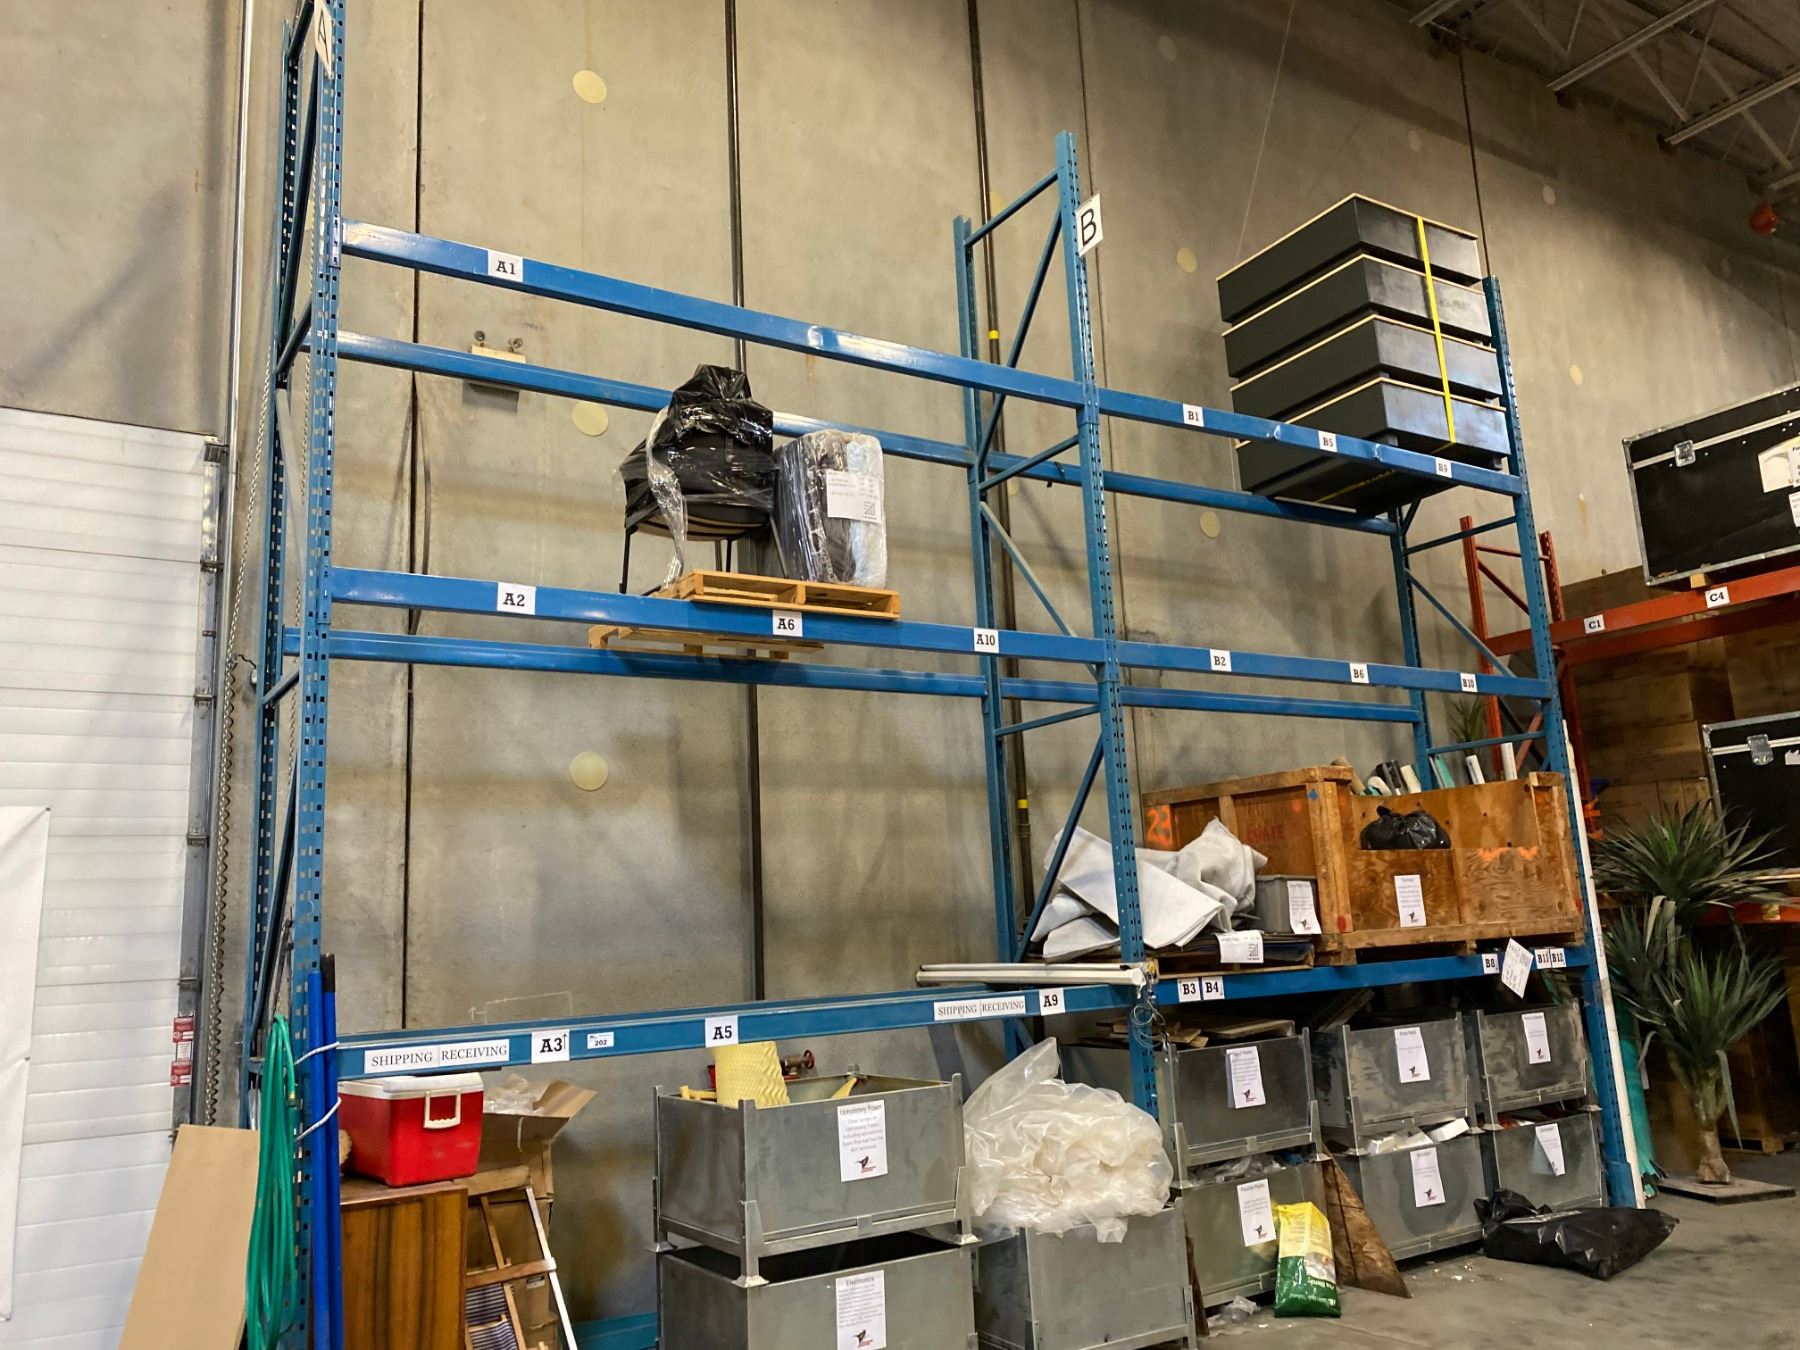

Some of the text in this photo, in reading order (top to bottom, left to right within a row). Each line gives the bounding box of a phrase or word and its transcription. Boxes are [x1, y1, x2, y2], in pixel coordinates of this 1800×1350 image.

[317, 9, 330, 64] A
[1081, 208, 1097, 247] B
[495, 260, 516, 275] A1
[1188, 410, 1200, 422] B1
[1323, 437, 1334, 447] B5
[1438, 462, 1448, 473] B9
[502, 592, 525, 607] A2
[1709, 591, 1724, 602] C4
[777, 618, 795, 630] A6
[1588, 621, 1602, 630] C1
[976, 634, 996, 646] A10
[1213, 656, 1227, 667] B2
[1353, 668, 1364, 679] B6
[1463, 678, 1474, 689] B10
[1537, 951, 1549, 963] B11
[1551, 953, 1563, 963] B12
[1182, 983, 1196, 995] B3
[1205, 981, 1219, 993] B4
[1043, 994, 1059, 1008] A9
[938, 1001, 1025, 1016] SHIPPING RECEIVING
[712, 1025, 732, 1040] A5
[539, 1038, 563, 1053] A3
[594, 1039, 607, 1047] 202
[371, 1045, 508, 1067] SHIPPING RECEIVING
